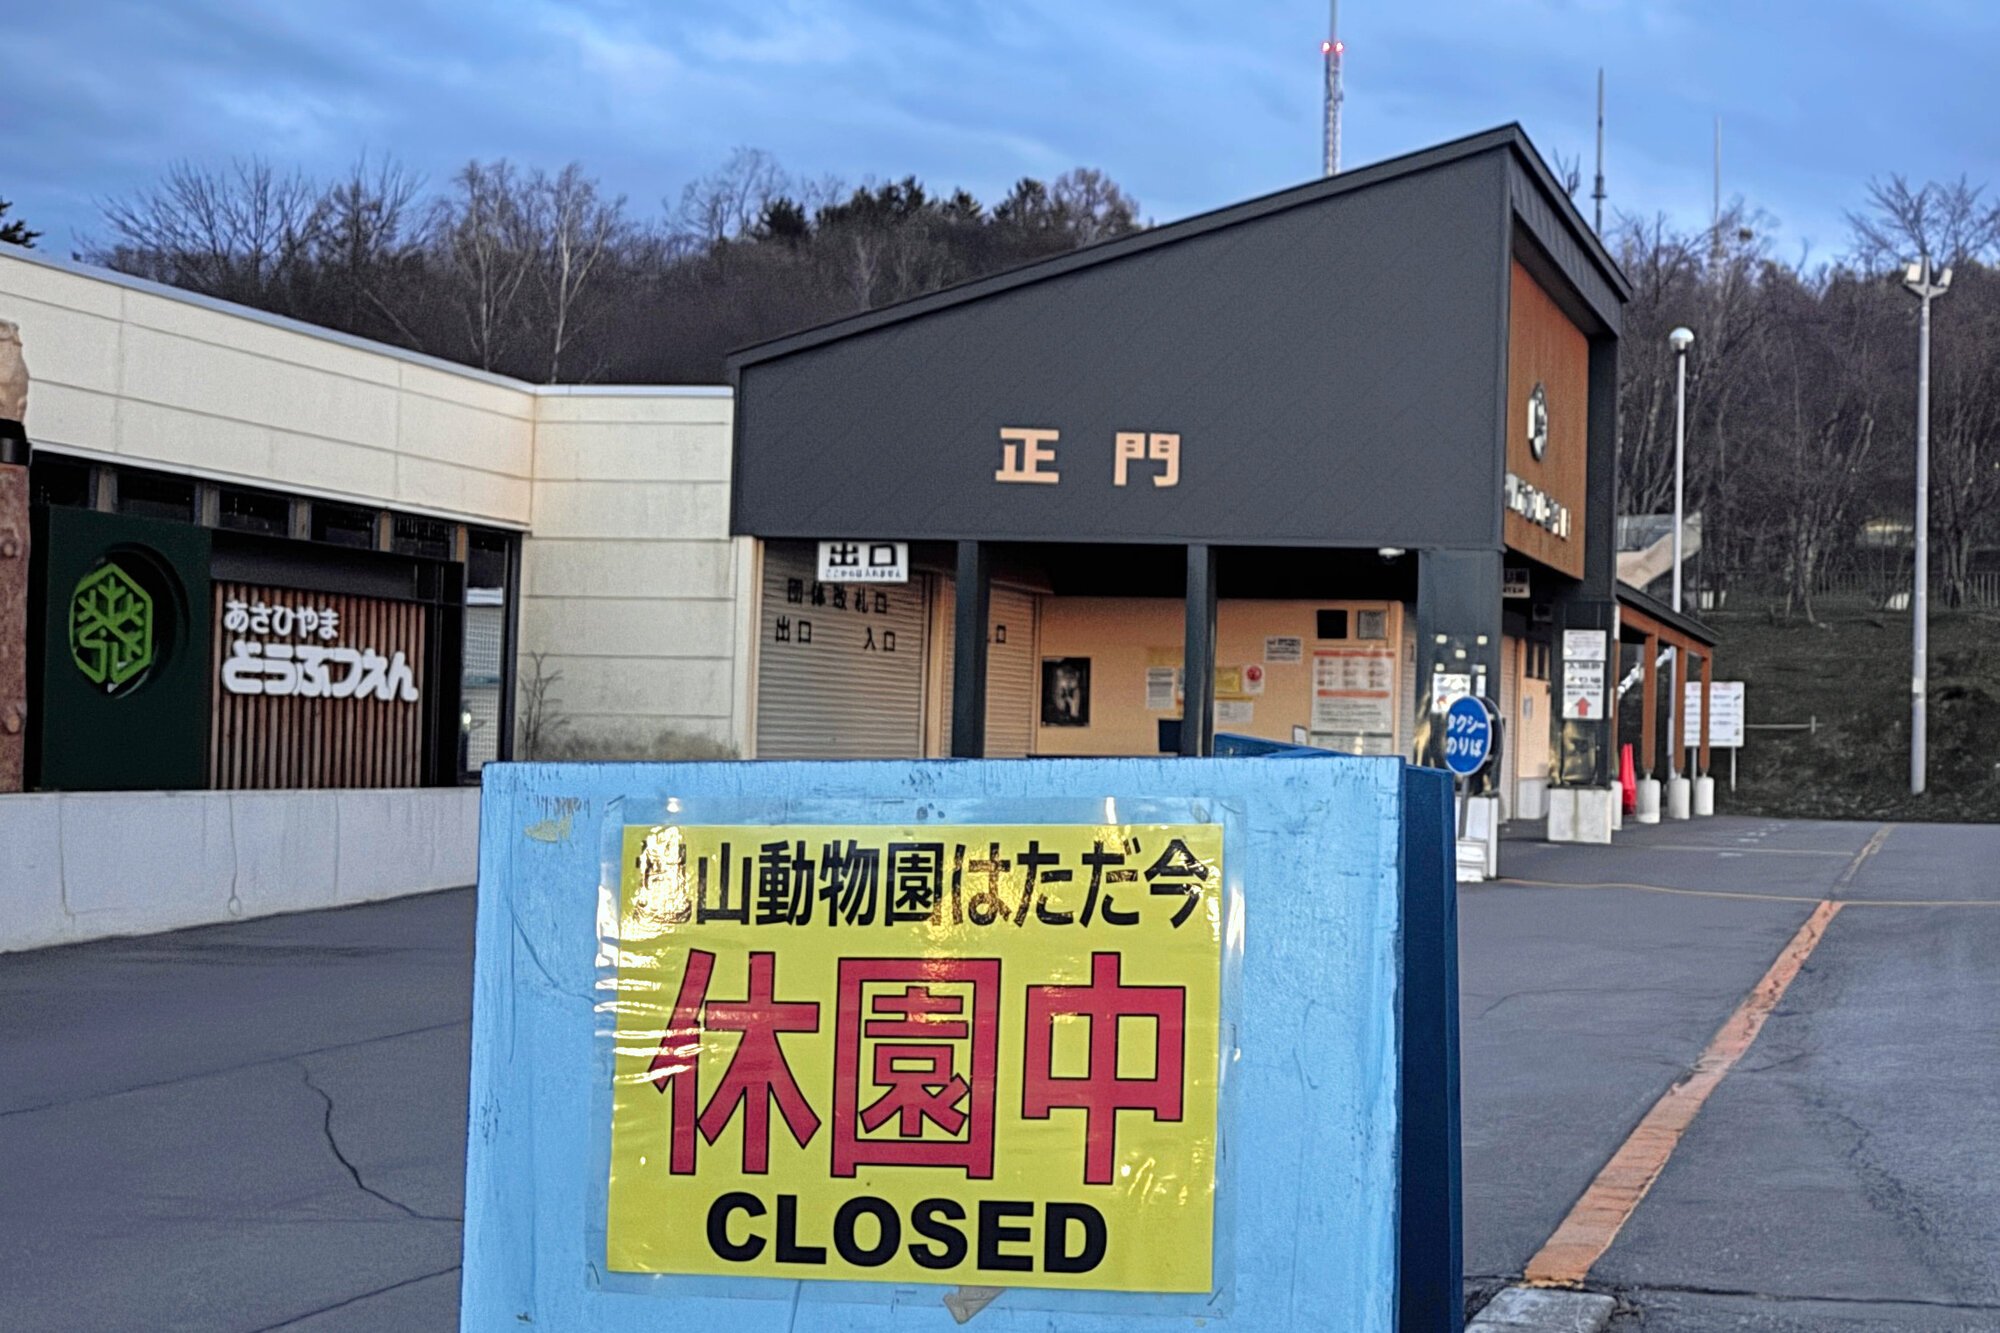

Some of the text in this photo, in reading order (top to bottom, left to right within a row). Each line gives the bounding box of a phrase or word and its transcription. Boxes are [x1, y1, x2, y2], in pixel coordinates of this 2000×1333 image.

[995, 427, 1180, 487] 正門
[829, 542, 898, 567] 出口
[224, 601, 339, 639] あさひやま
[775, 615, 812, 643] 出口
[863, 626, 896, 652] 入口
[1446, 736, 1485, 757] のりば
[651, 948, 1187, 1186] 休園中
[706, 1191, 1108, 1274] CLOSED
